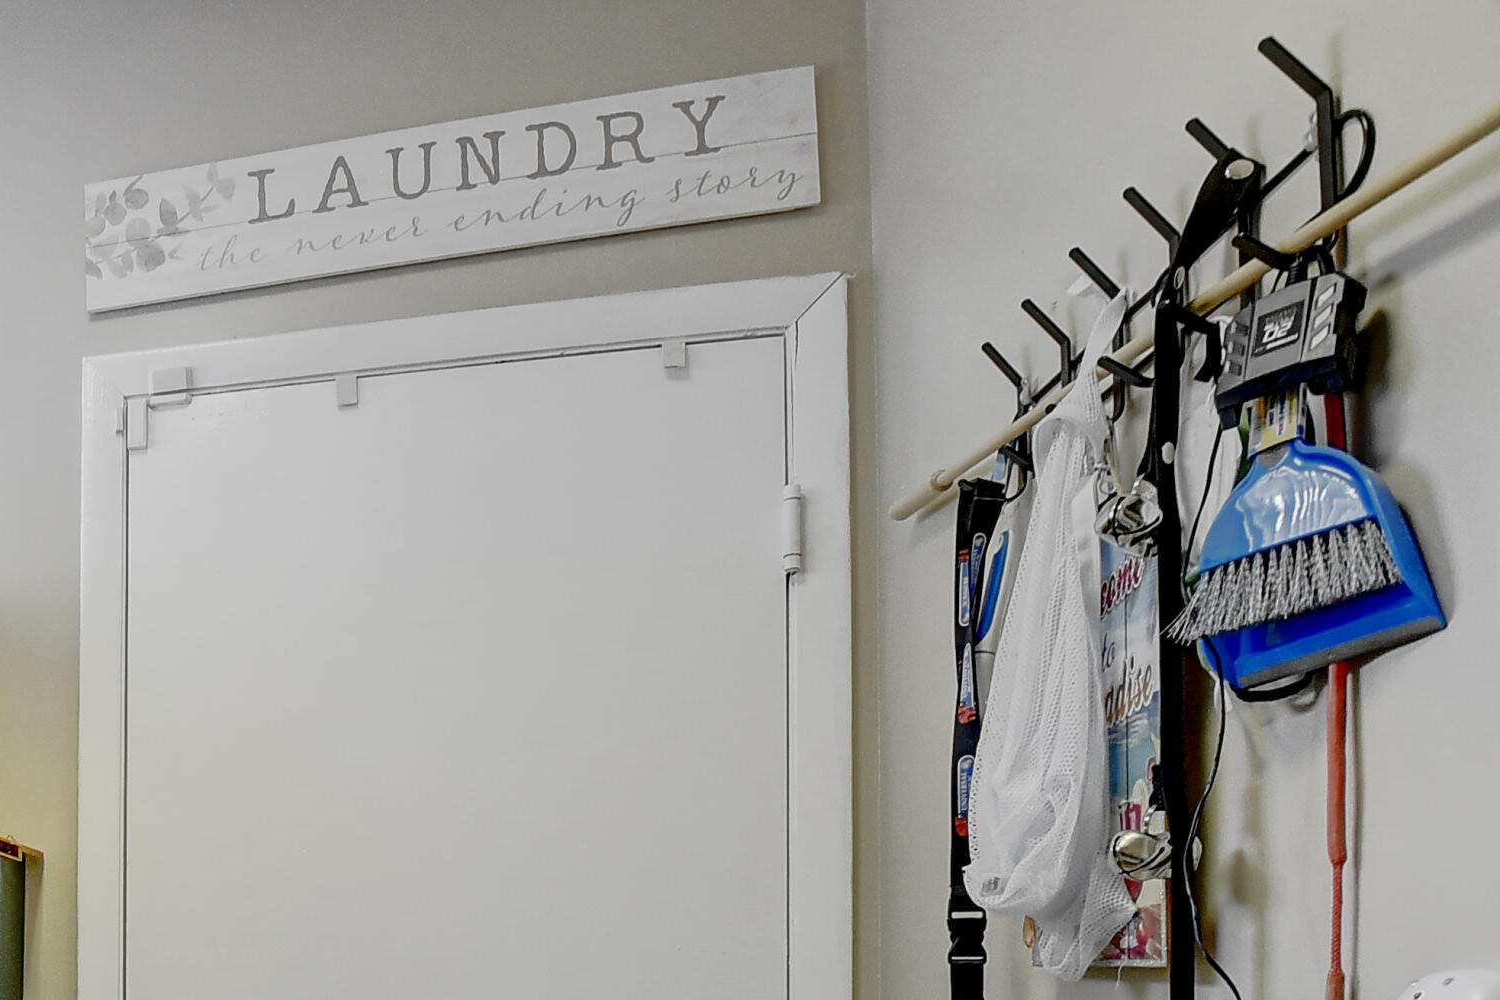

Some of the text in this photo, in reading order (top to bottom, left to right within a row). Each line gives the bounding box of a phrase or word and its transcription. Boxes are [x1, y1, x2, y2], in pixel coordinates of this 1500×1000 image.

[247, 95, 727, 224] LAUNDRY
[200, 166, 805, 271] the never ending story
